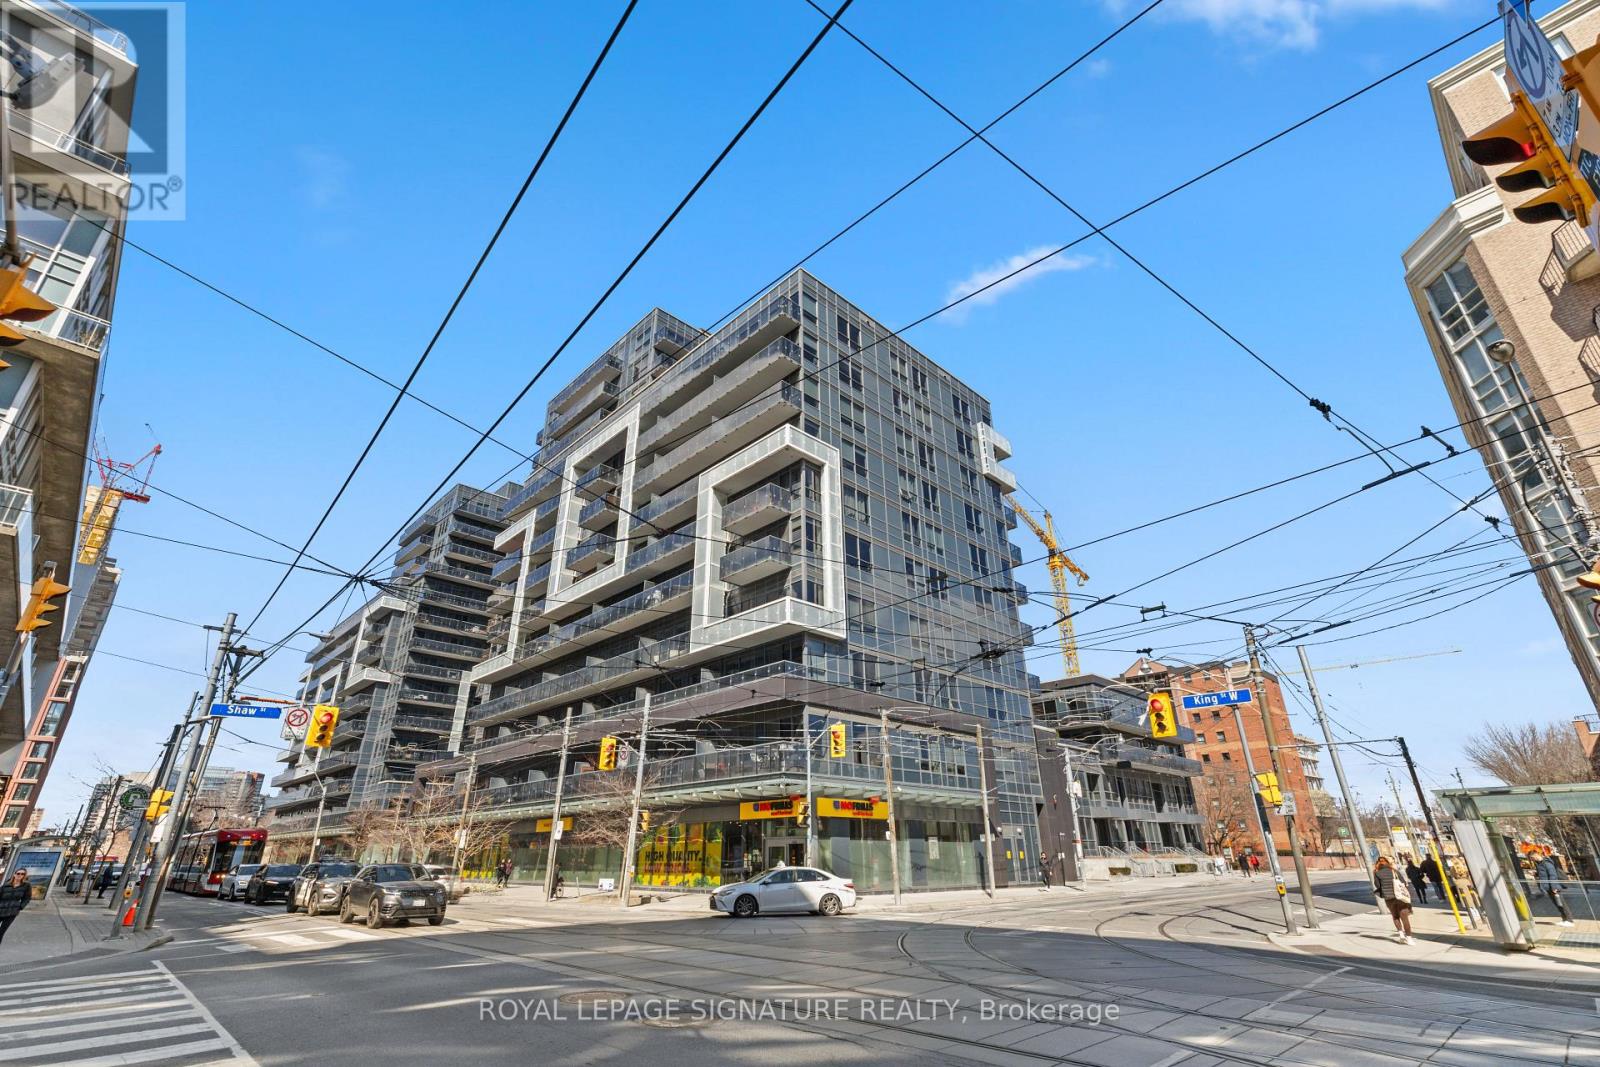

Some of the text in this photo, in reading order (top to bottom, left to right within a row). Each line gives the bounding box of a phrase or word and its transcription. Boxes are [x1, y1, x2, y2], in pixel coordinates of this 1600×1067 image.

[1193, 694, 1219, 705] King
[1228, 691, 1238, 701] W
[227, 705, 257, 715] Shaw
